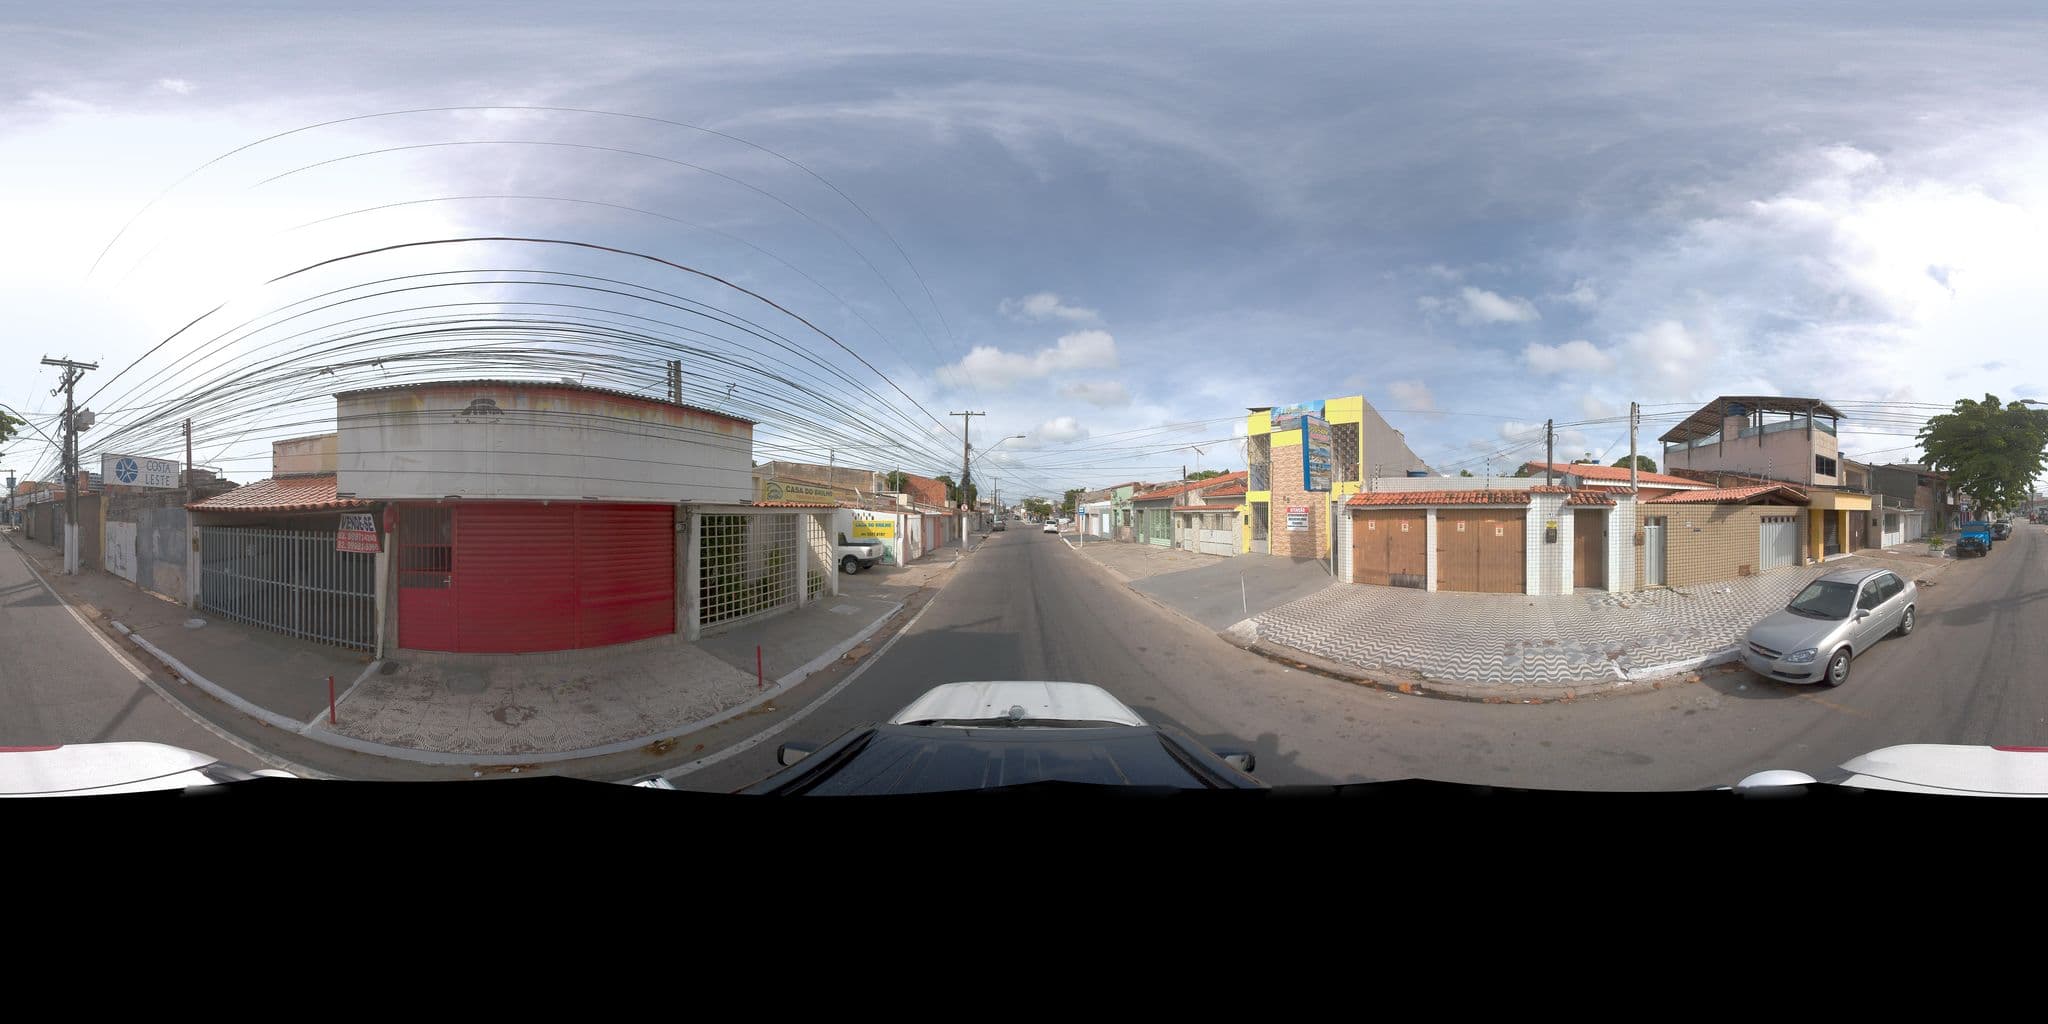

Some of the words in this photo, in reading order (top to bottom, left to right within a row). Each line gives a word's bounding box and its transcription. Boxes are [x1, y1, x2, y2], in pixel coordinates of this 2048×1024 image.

[146, 460, 171, 473] COSTA
[145, 474, 170, 486] LESTE
[785, 484, 804, 494] CASA
